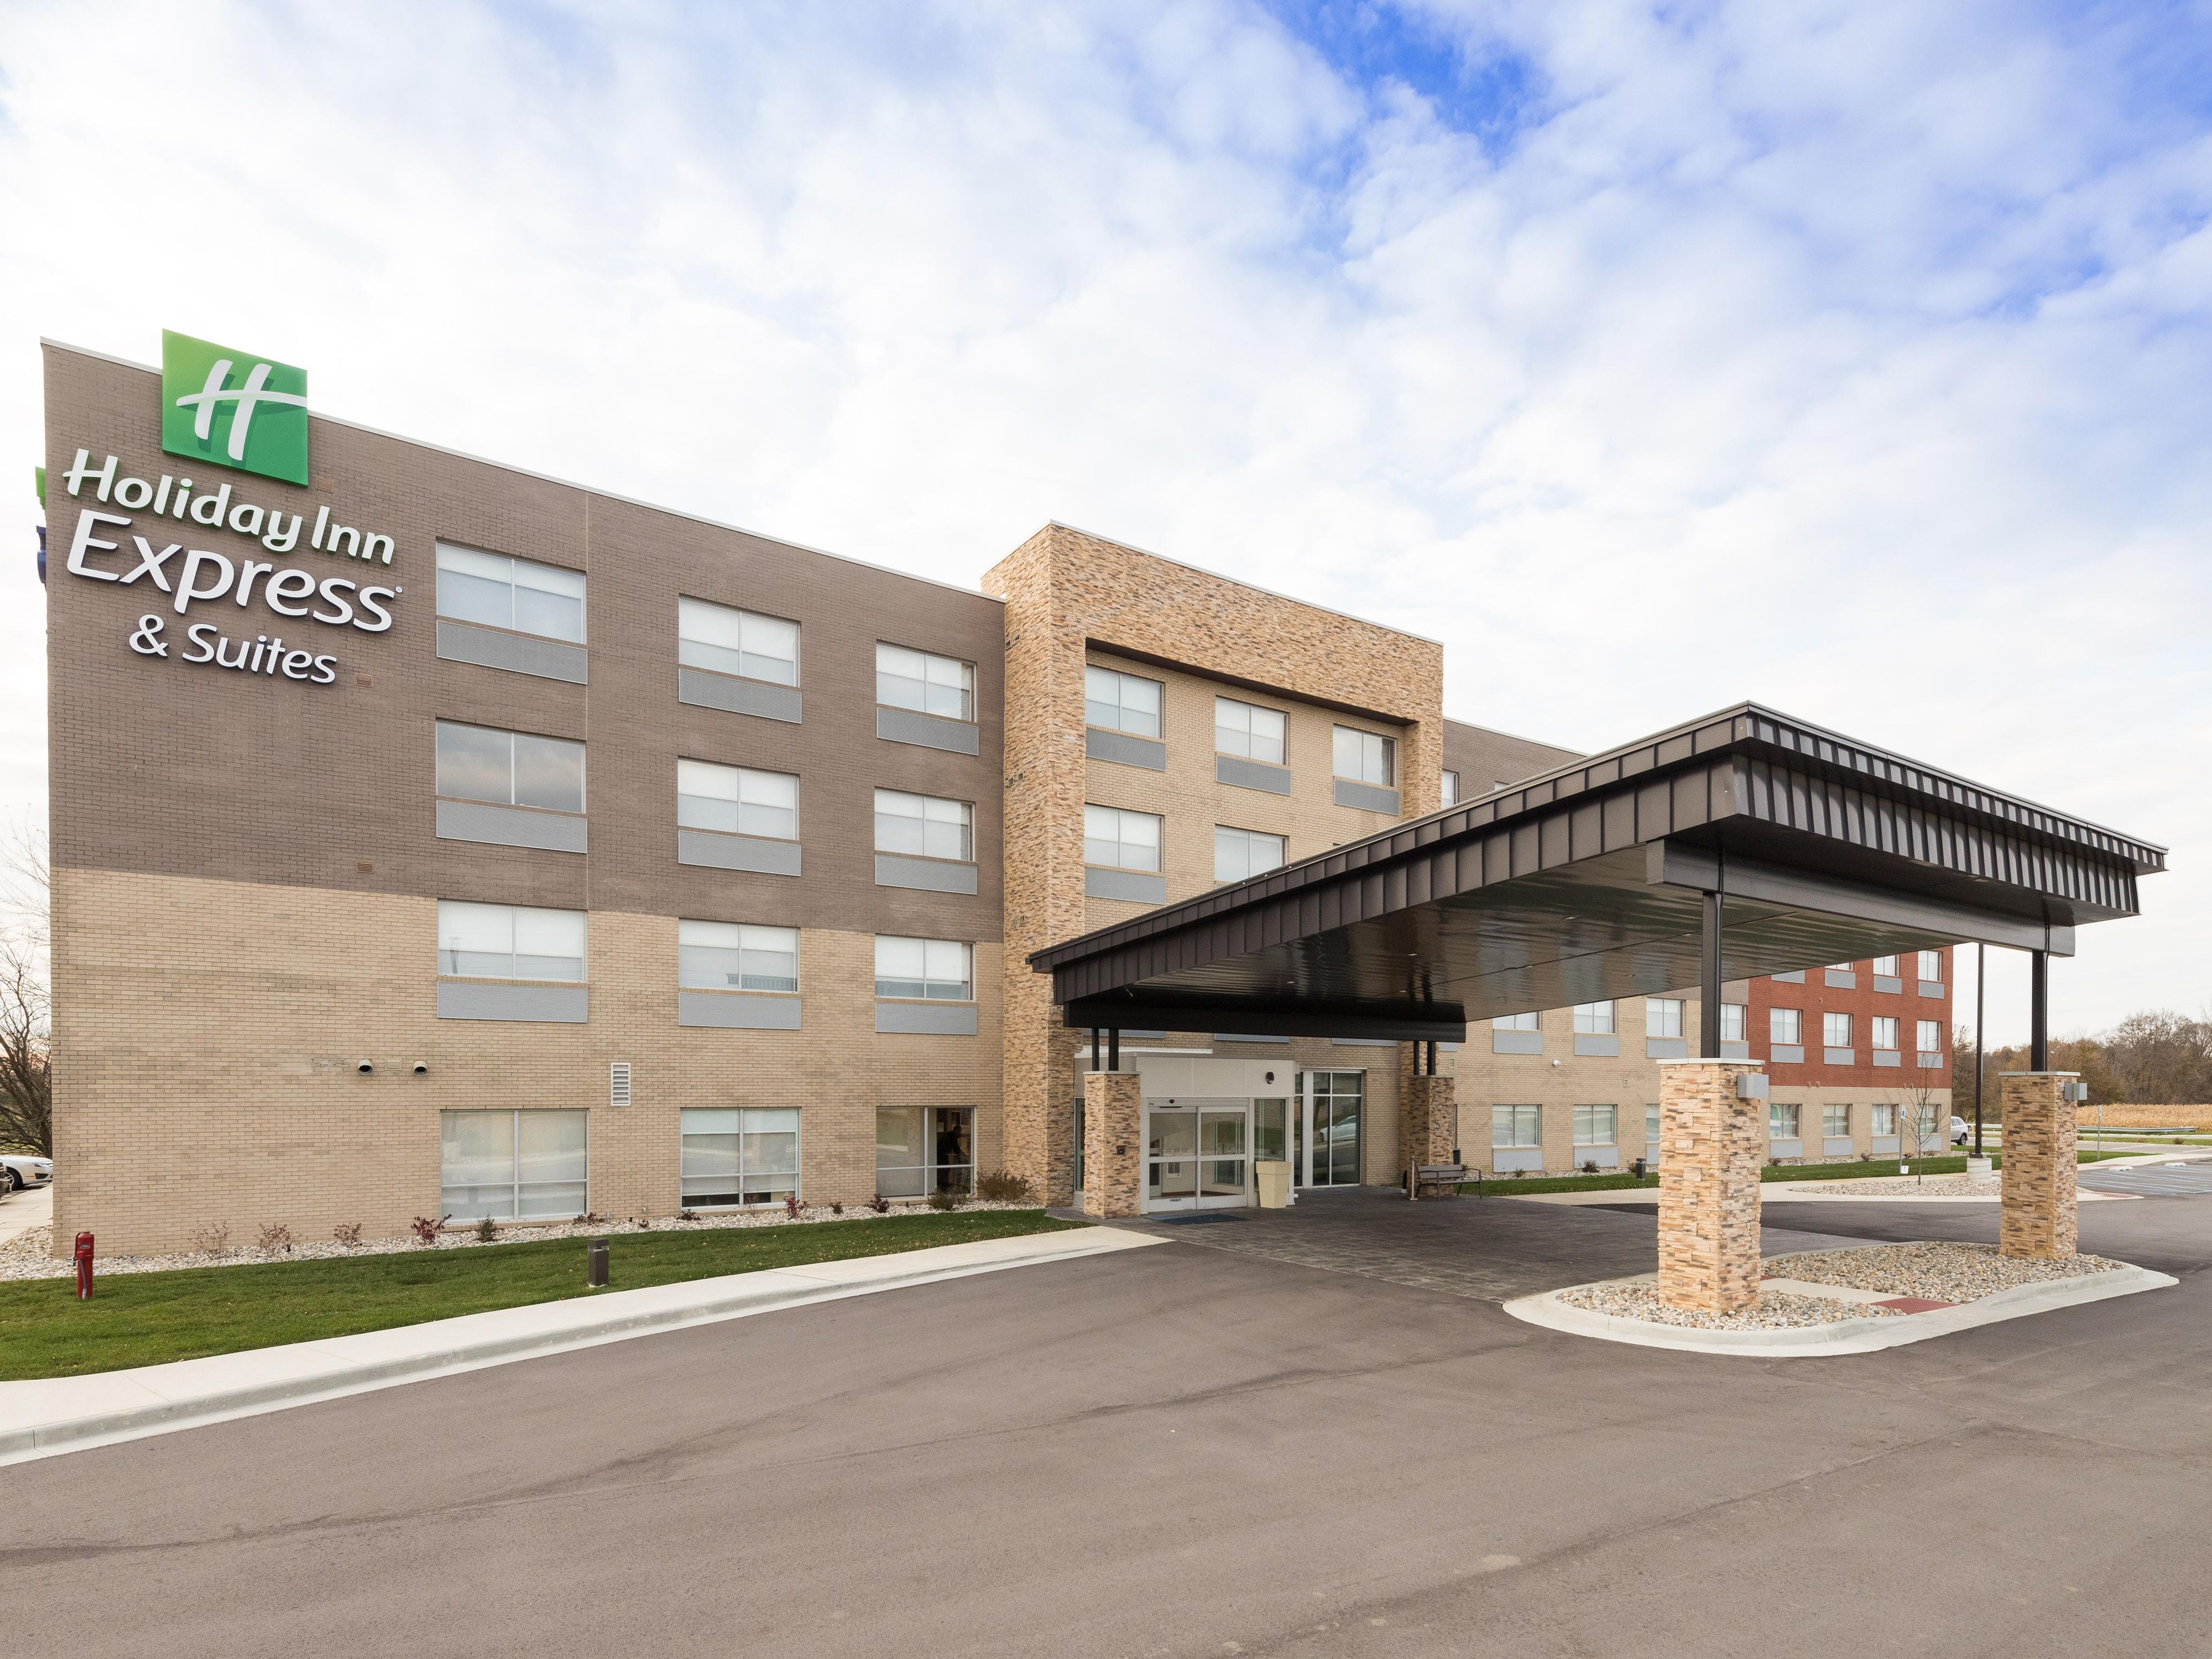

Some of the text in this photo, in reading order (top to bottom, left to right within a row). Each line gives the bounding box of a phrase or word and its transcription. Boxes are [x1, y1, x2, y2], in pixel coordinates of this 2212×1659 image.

[62, 448, 395, 564] Holiday Inn
[129, 614, 337, 684] & Suites
